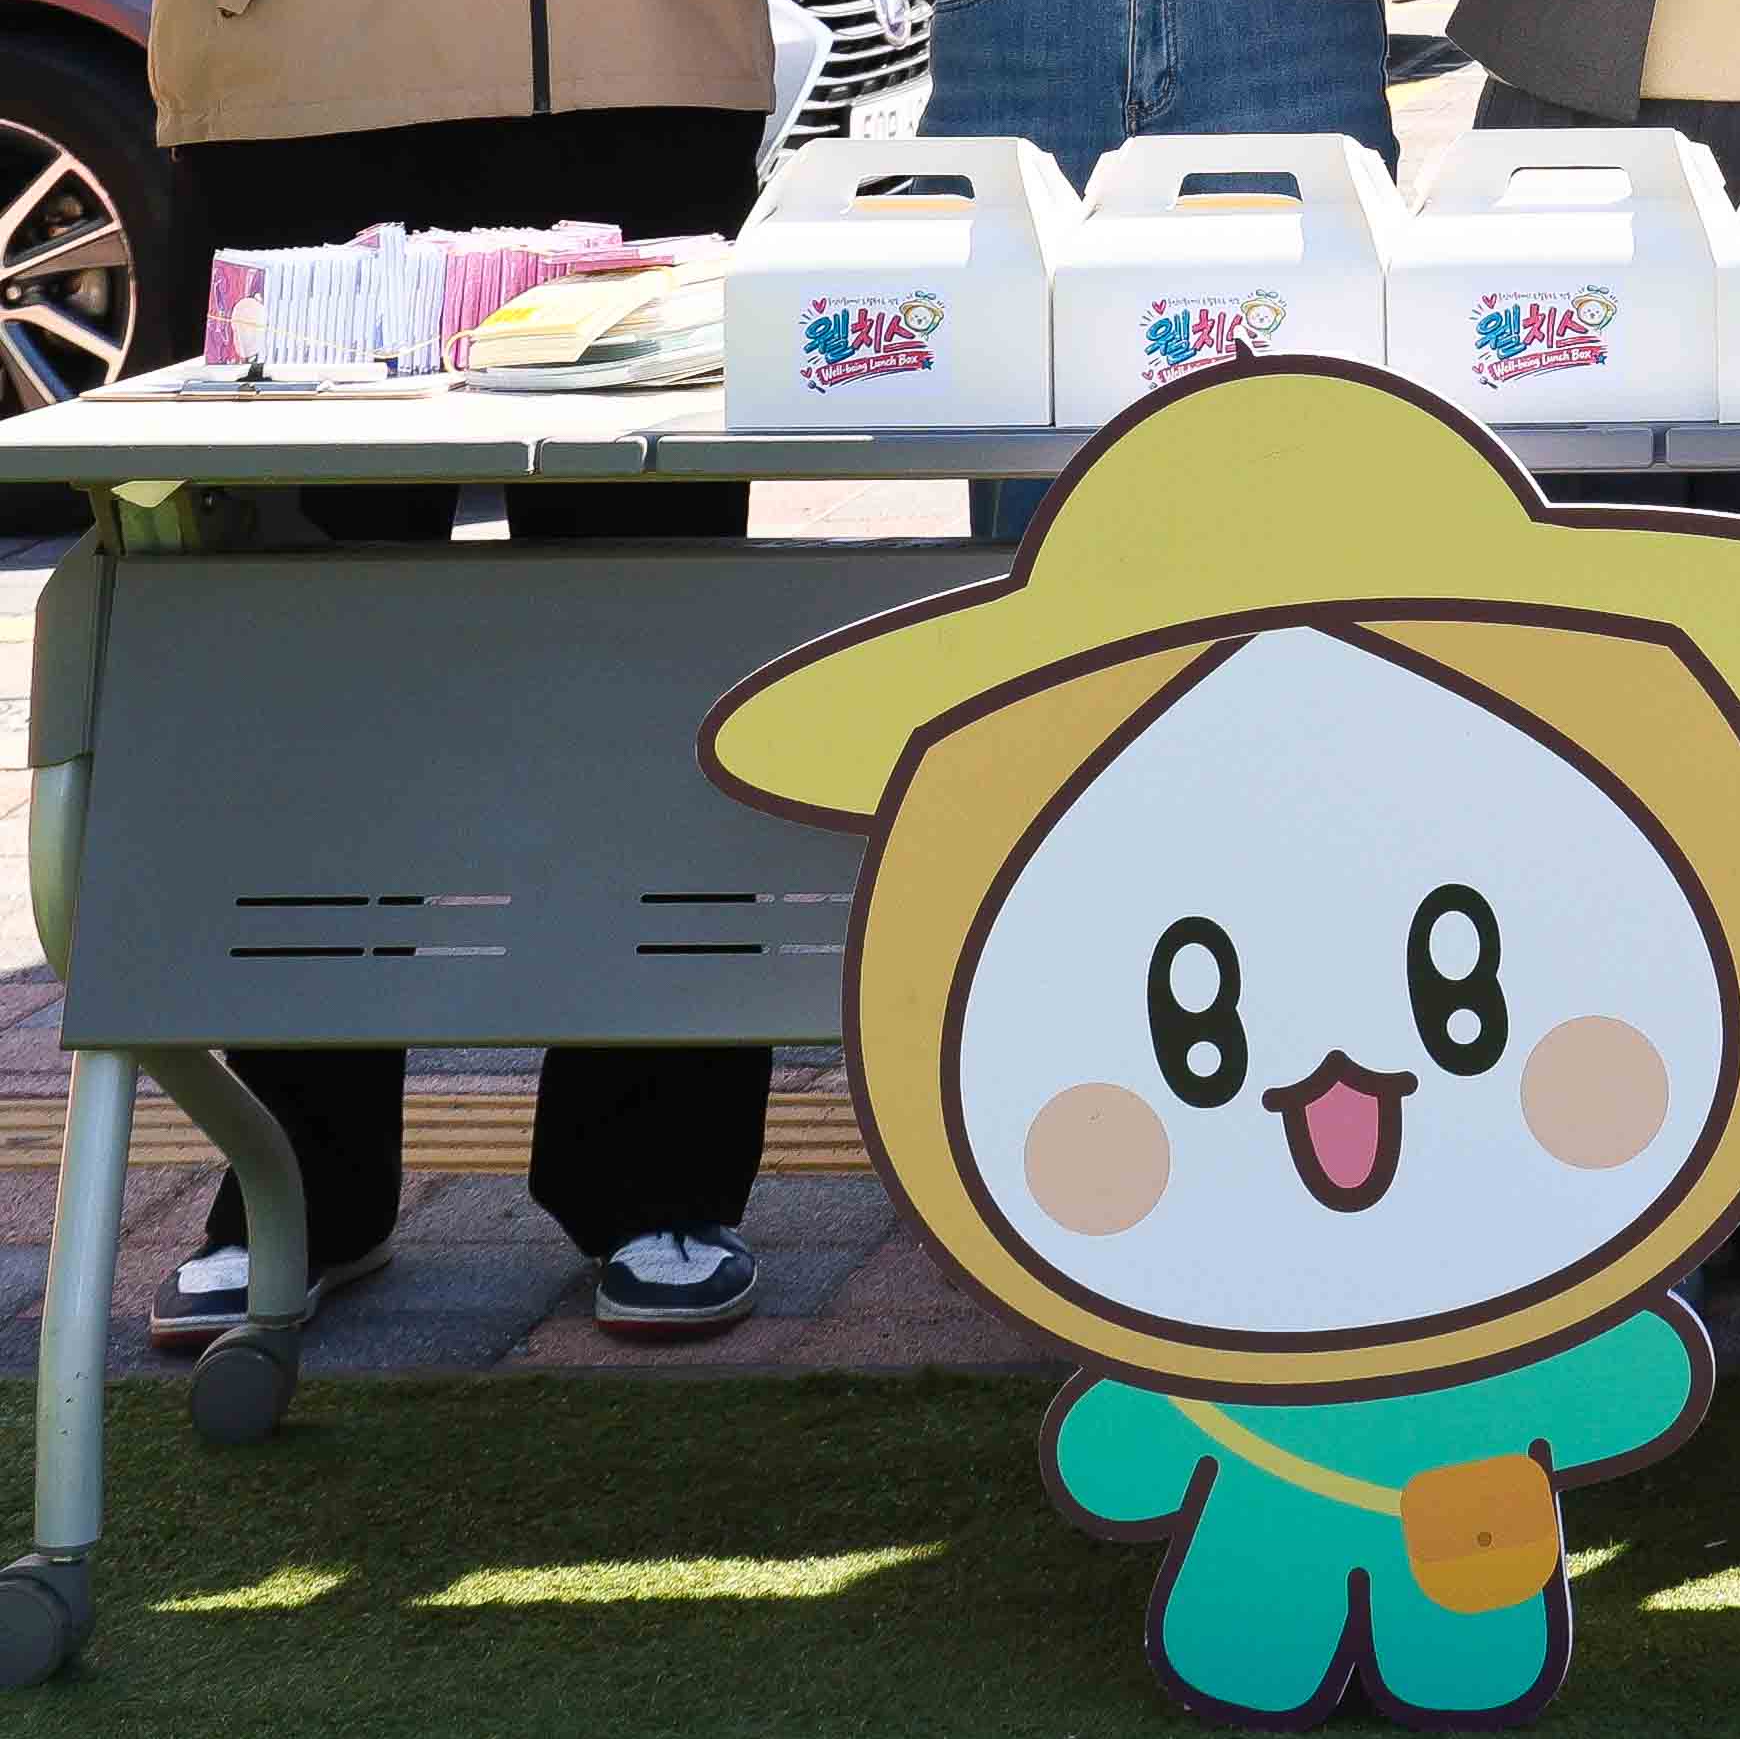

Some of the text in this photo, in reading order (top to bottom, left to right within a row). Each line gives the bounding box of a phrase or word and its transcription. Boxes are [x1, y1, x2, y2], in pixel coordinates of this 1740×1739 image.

[803, 308, 928, 365] 웰치스
[1475, 304, 1602, 359] 웰치스
[899, 354, 918, 365] Box
[1572, 348, 1592, 360] Box
